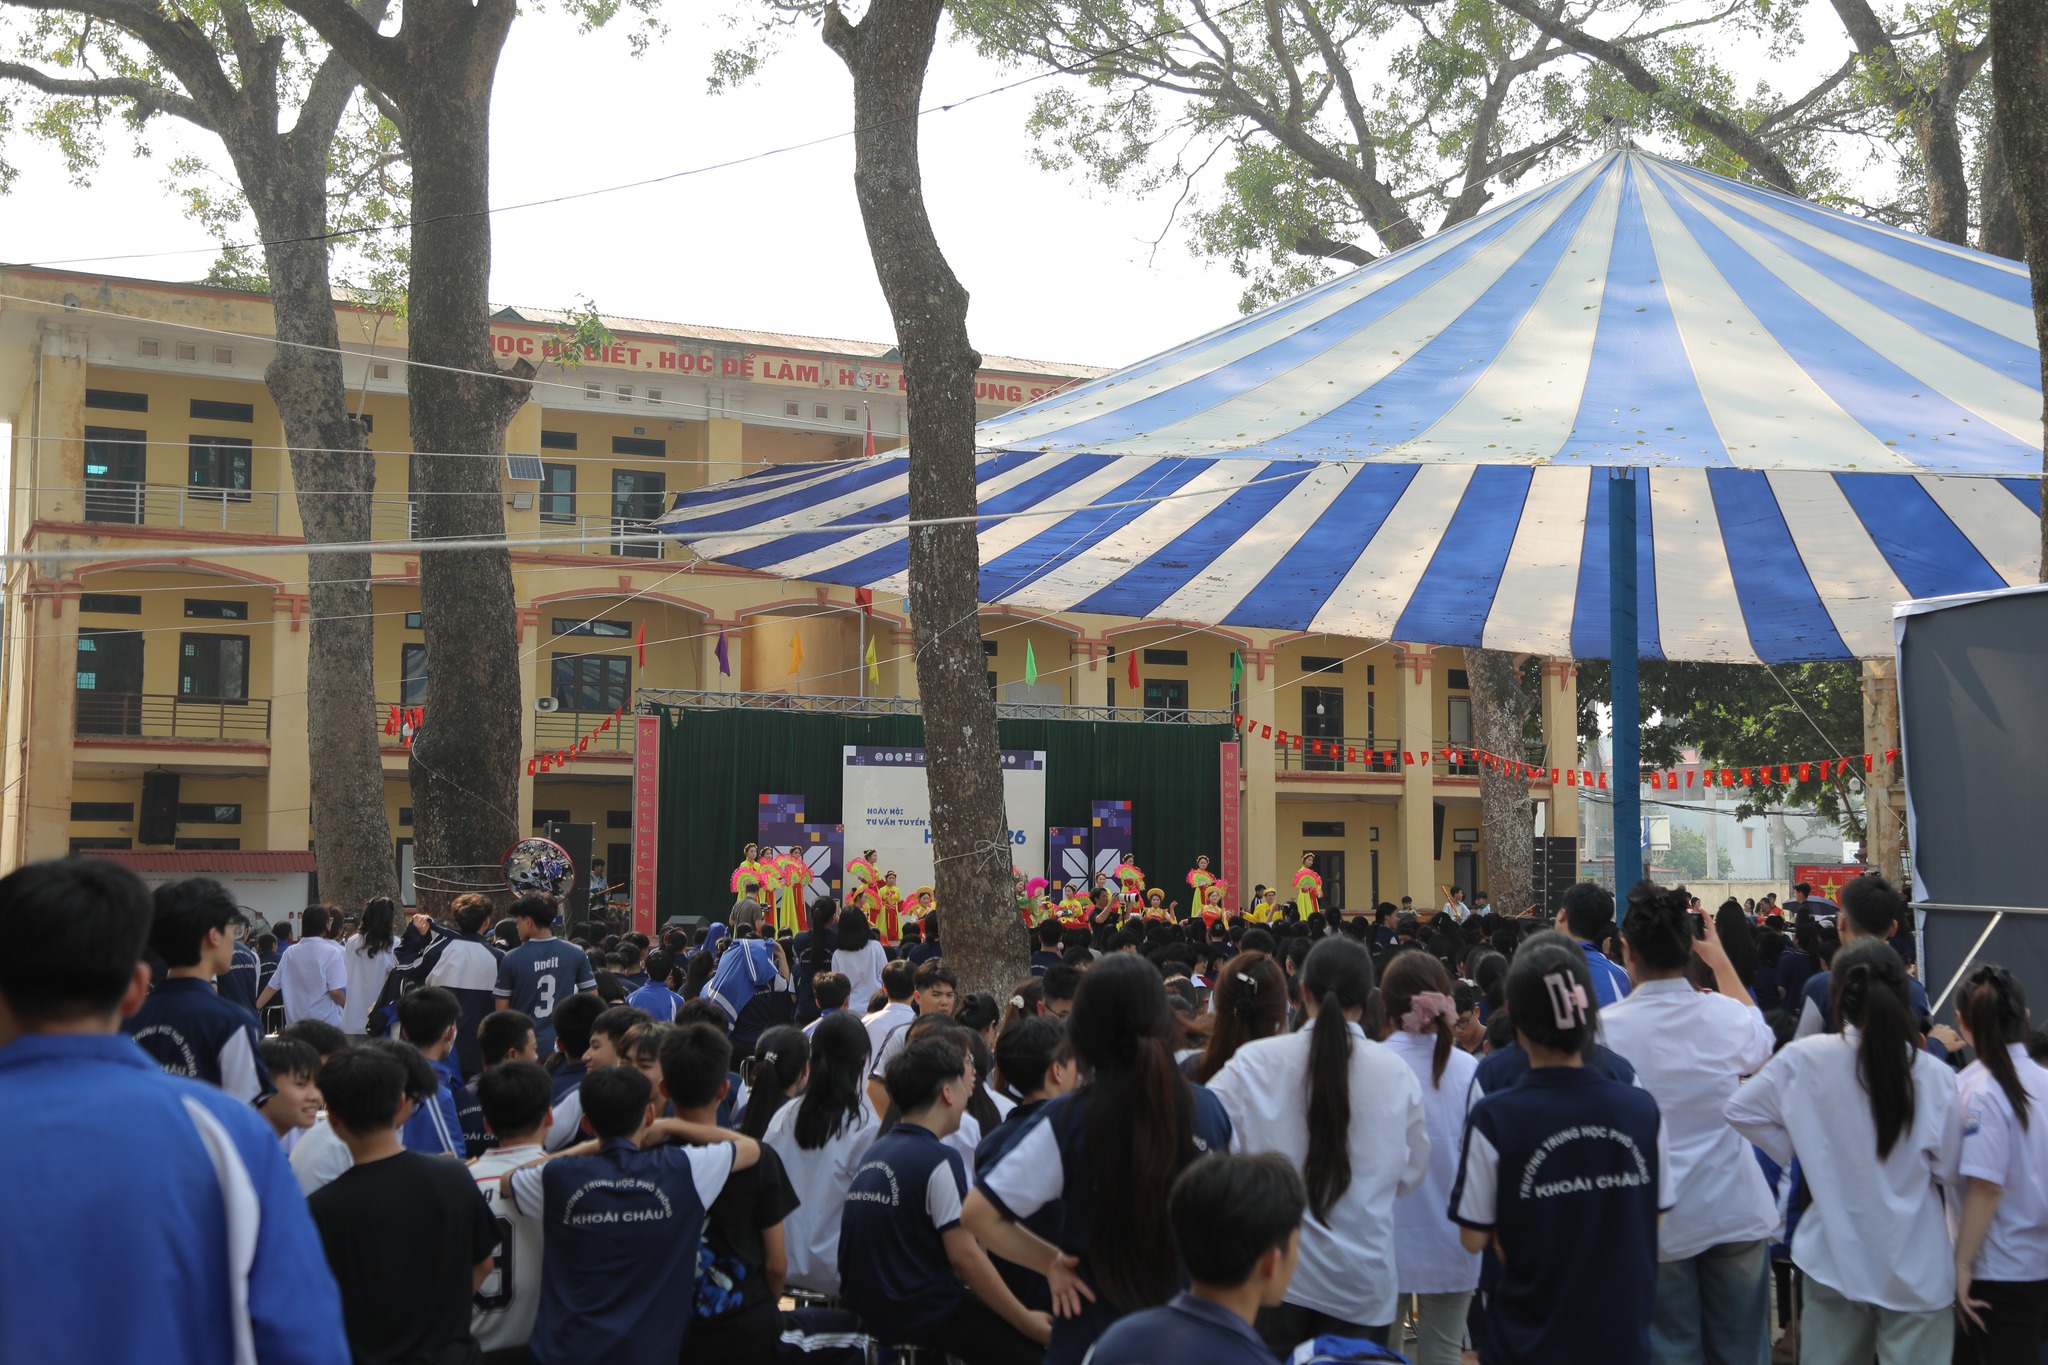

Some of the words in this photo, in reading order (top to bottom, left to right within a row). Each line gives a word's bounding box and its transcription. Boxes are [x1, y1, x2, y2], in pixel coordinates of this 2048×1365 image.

[659, 351, 713, 374] HỌC
[721, 353, 756, 377] ĐỂ
[763, 359, 831, 387] LÀM,
[839, 369, 890, 390] HỌC
[867, 807, 888, 815] NGÀY
[890, 807, 904, 816] HỘI
[534, 974, 556, 1018] 3
[459, 1105, 483, 1117] TRUNG
[1542, 1126, 1581, 1151] TRUNG
[1580, 1125, 1608, 1139] HỌC
[615, 1178, 636, 1189] HỌC
[1534, 1176, 1593, 1198] KHOÁI
[1595, 1171, 1641, 1189] CHÂU
[572, 1209, 619, 1225] KHOÁI
[622, 1208, 665, 1222] CHÂU
